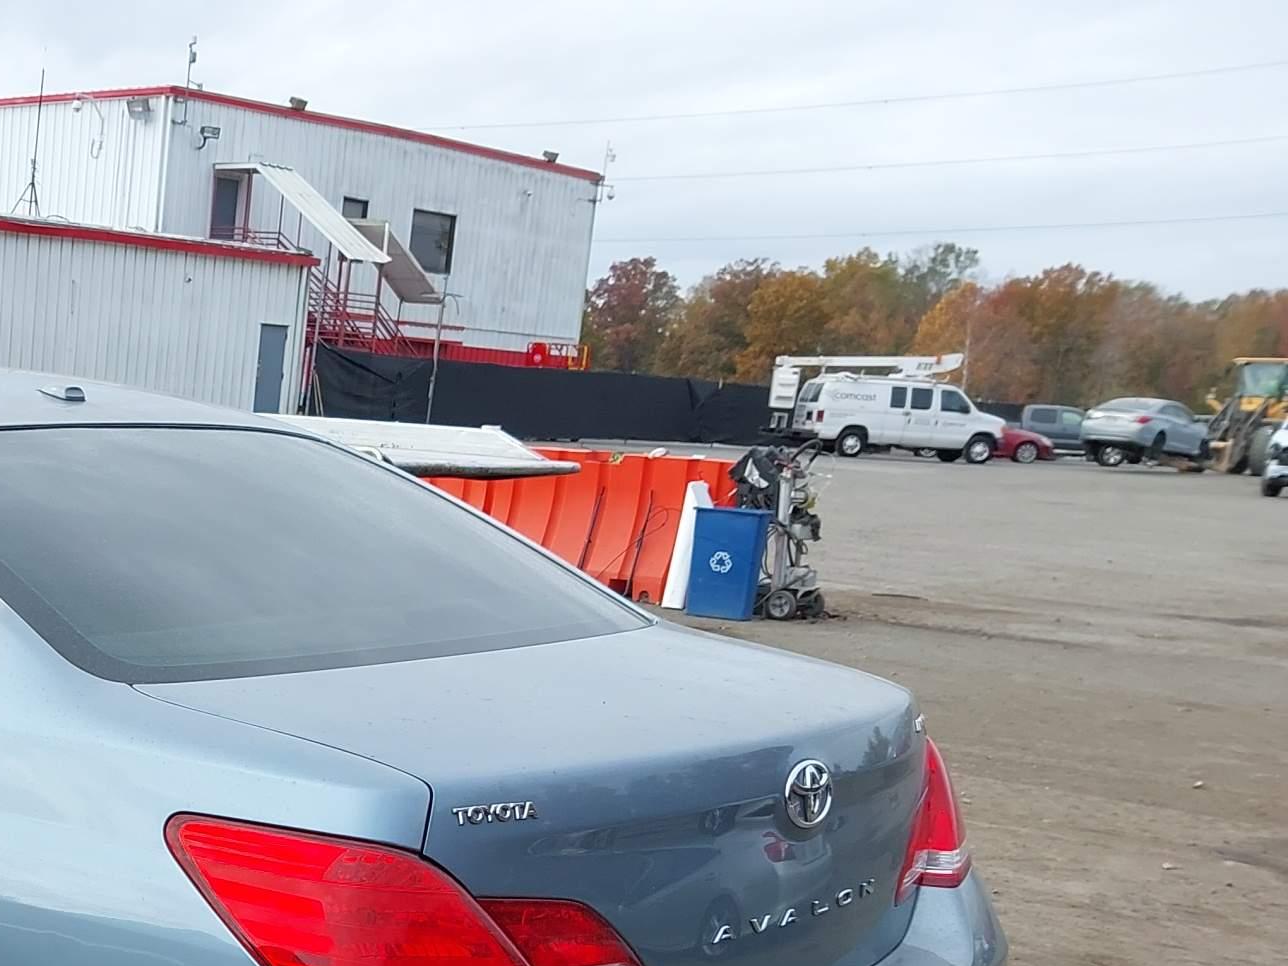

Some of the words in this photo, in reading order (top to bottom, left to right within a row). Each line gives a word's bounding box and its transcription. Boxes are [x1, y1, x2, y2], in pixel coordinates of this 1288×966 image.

[834, 391, 877, 401] comcast
[452, 801, 538, 826] TOYOTA
[712, 877, 876, 944] AVALON
